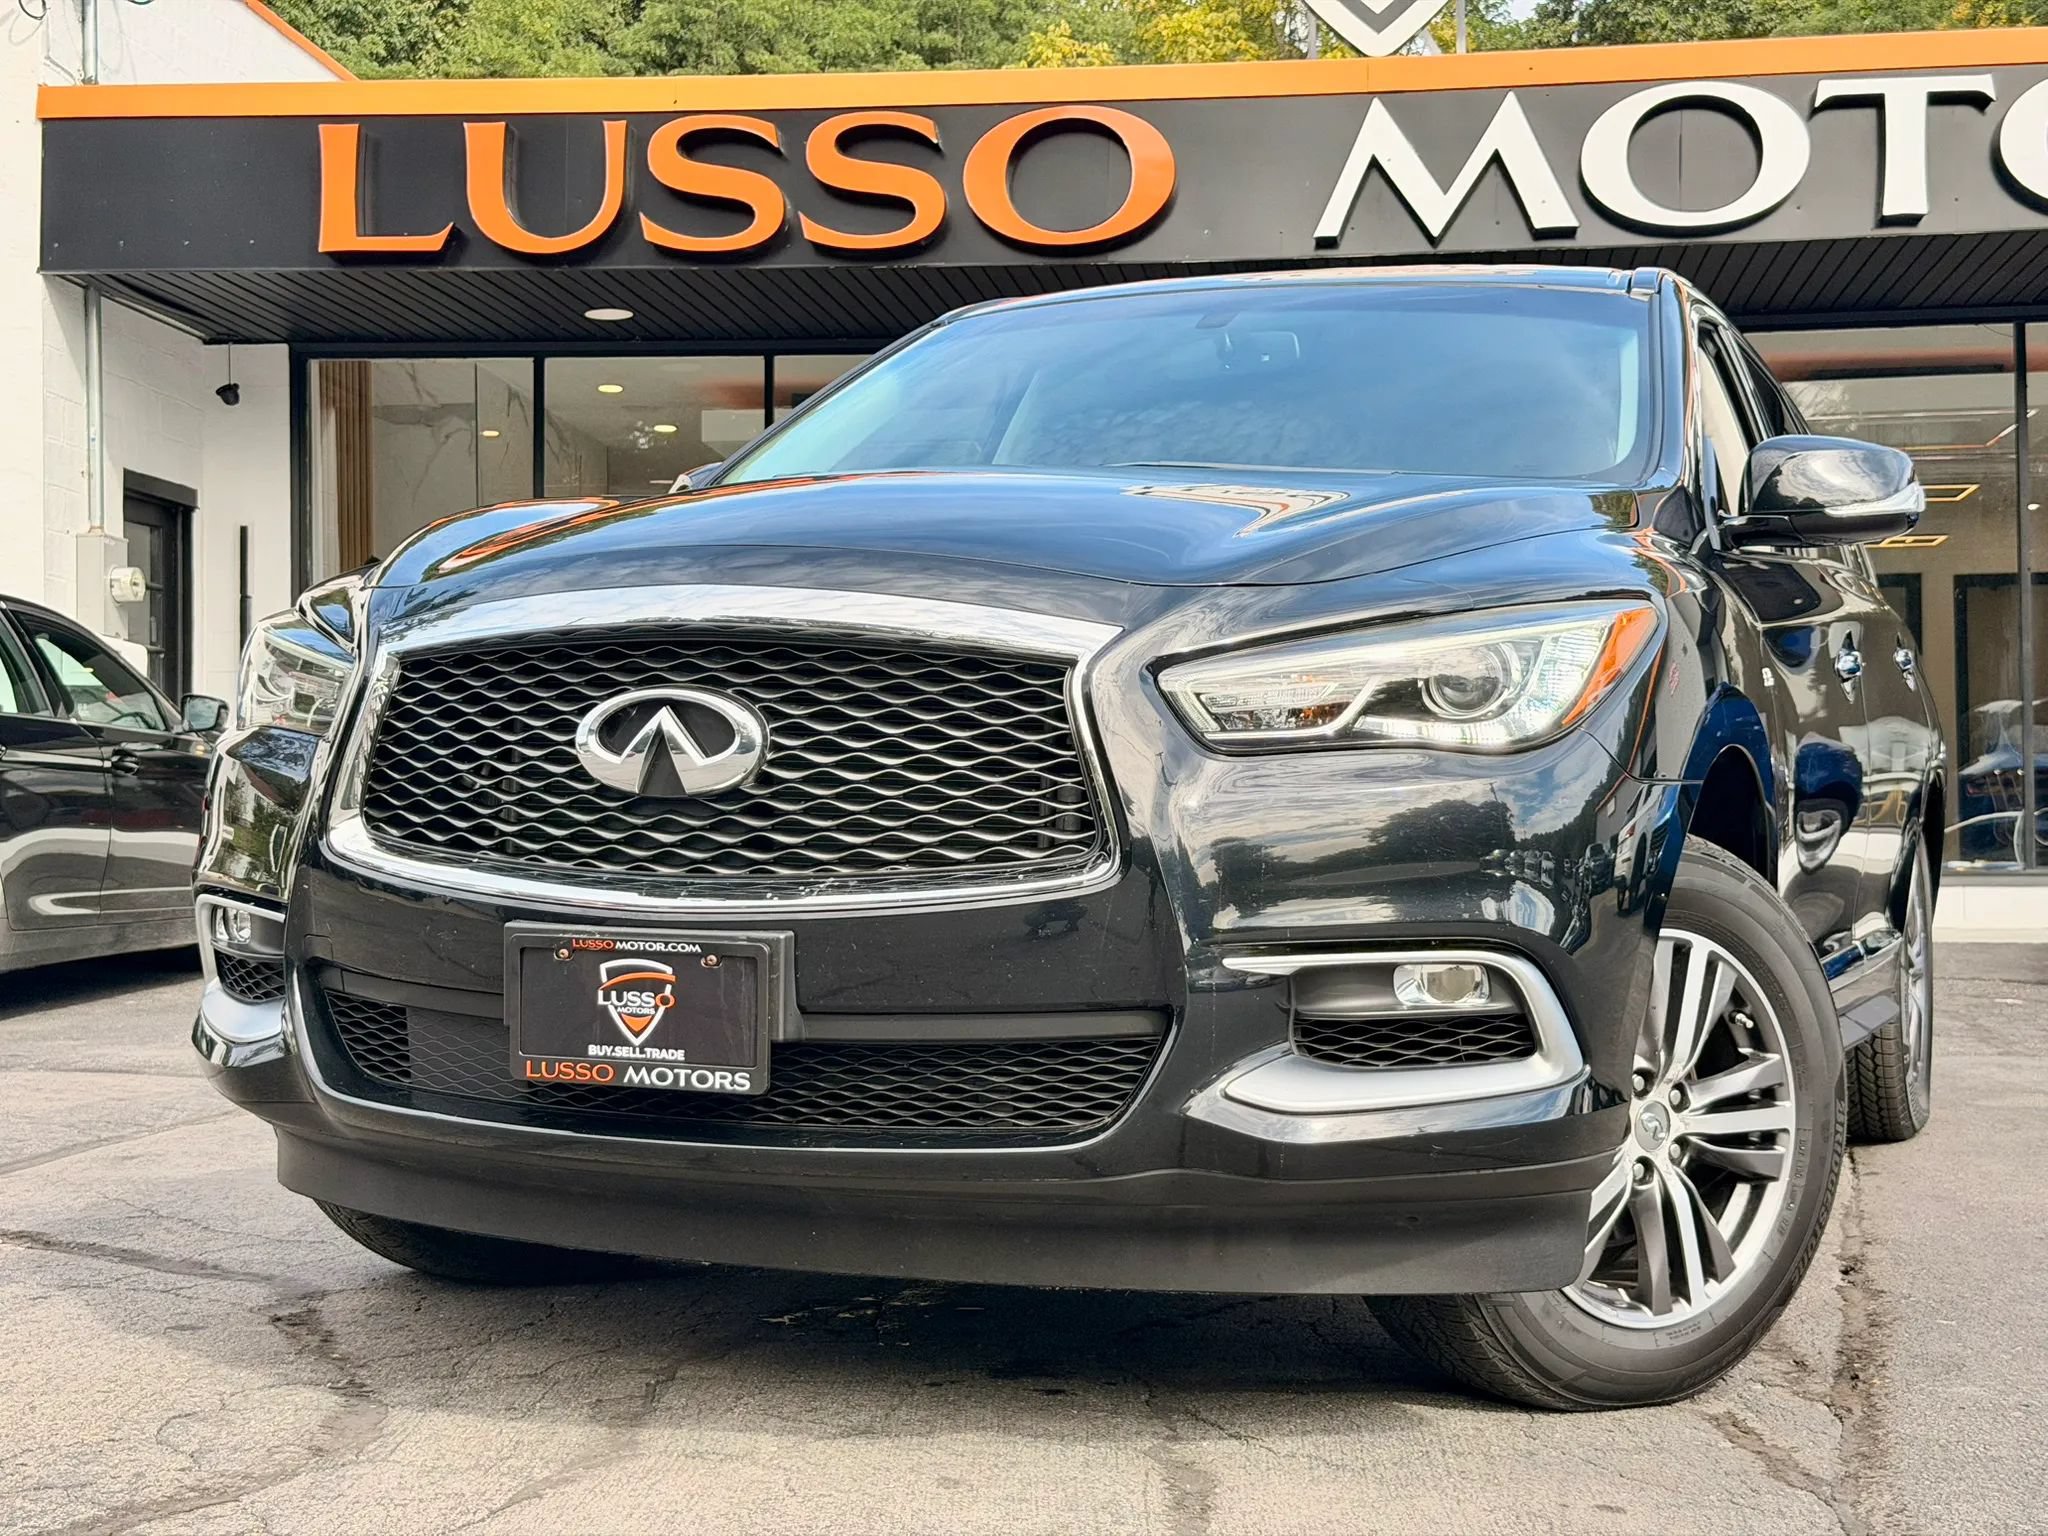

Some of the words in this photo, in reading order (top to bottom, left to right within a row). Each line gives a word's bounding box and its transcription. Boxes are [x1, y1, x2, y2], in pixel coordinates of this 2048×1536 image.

[317, 105, 1177, 254] LUSSO
[1312, 73, 2048, 242] MOT
[597, 989, 676, 1008] LUSSO
[616, 1006, 656, 1015] MOTORS
[588, 1044, 686, 1061] BUY.SELL.TRADE
[526, 1060, 615, 1082] LUSSO
[623, 1065, 751, 1091] MOTORS
